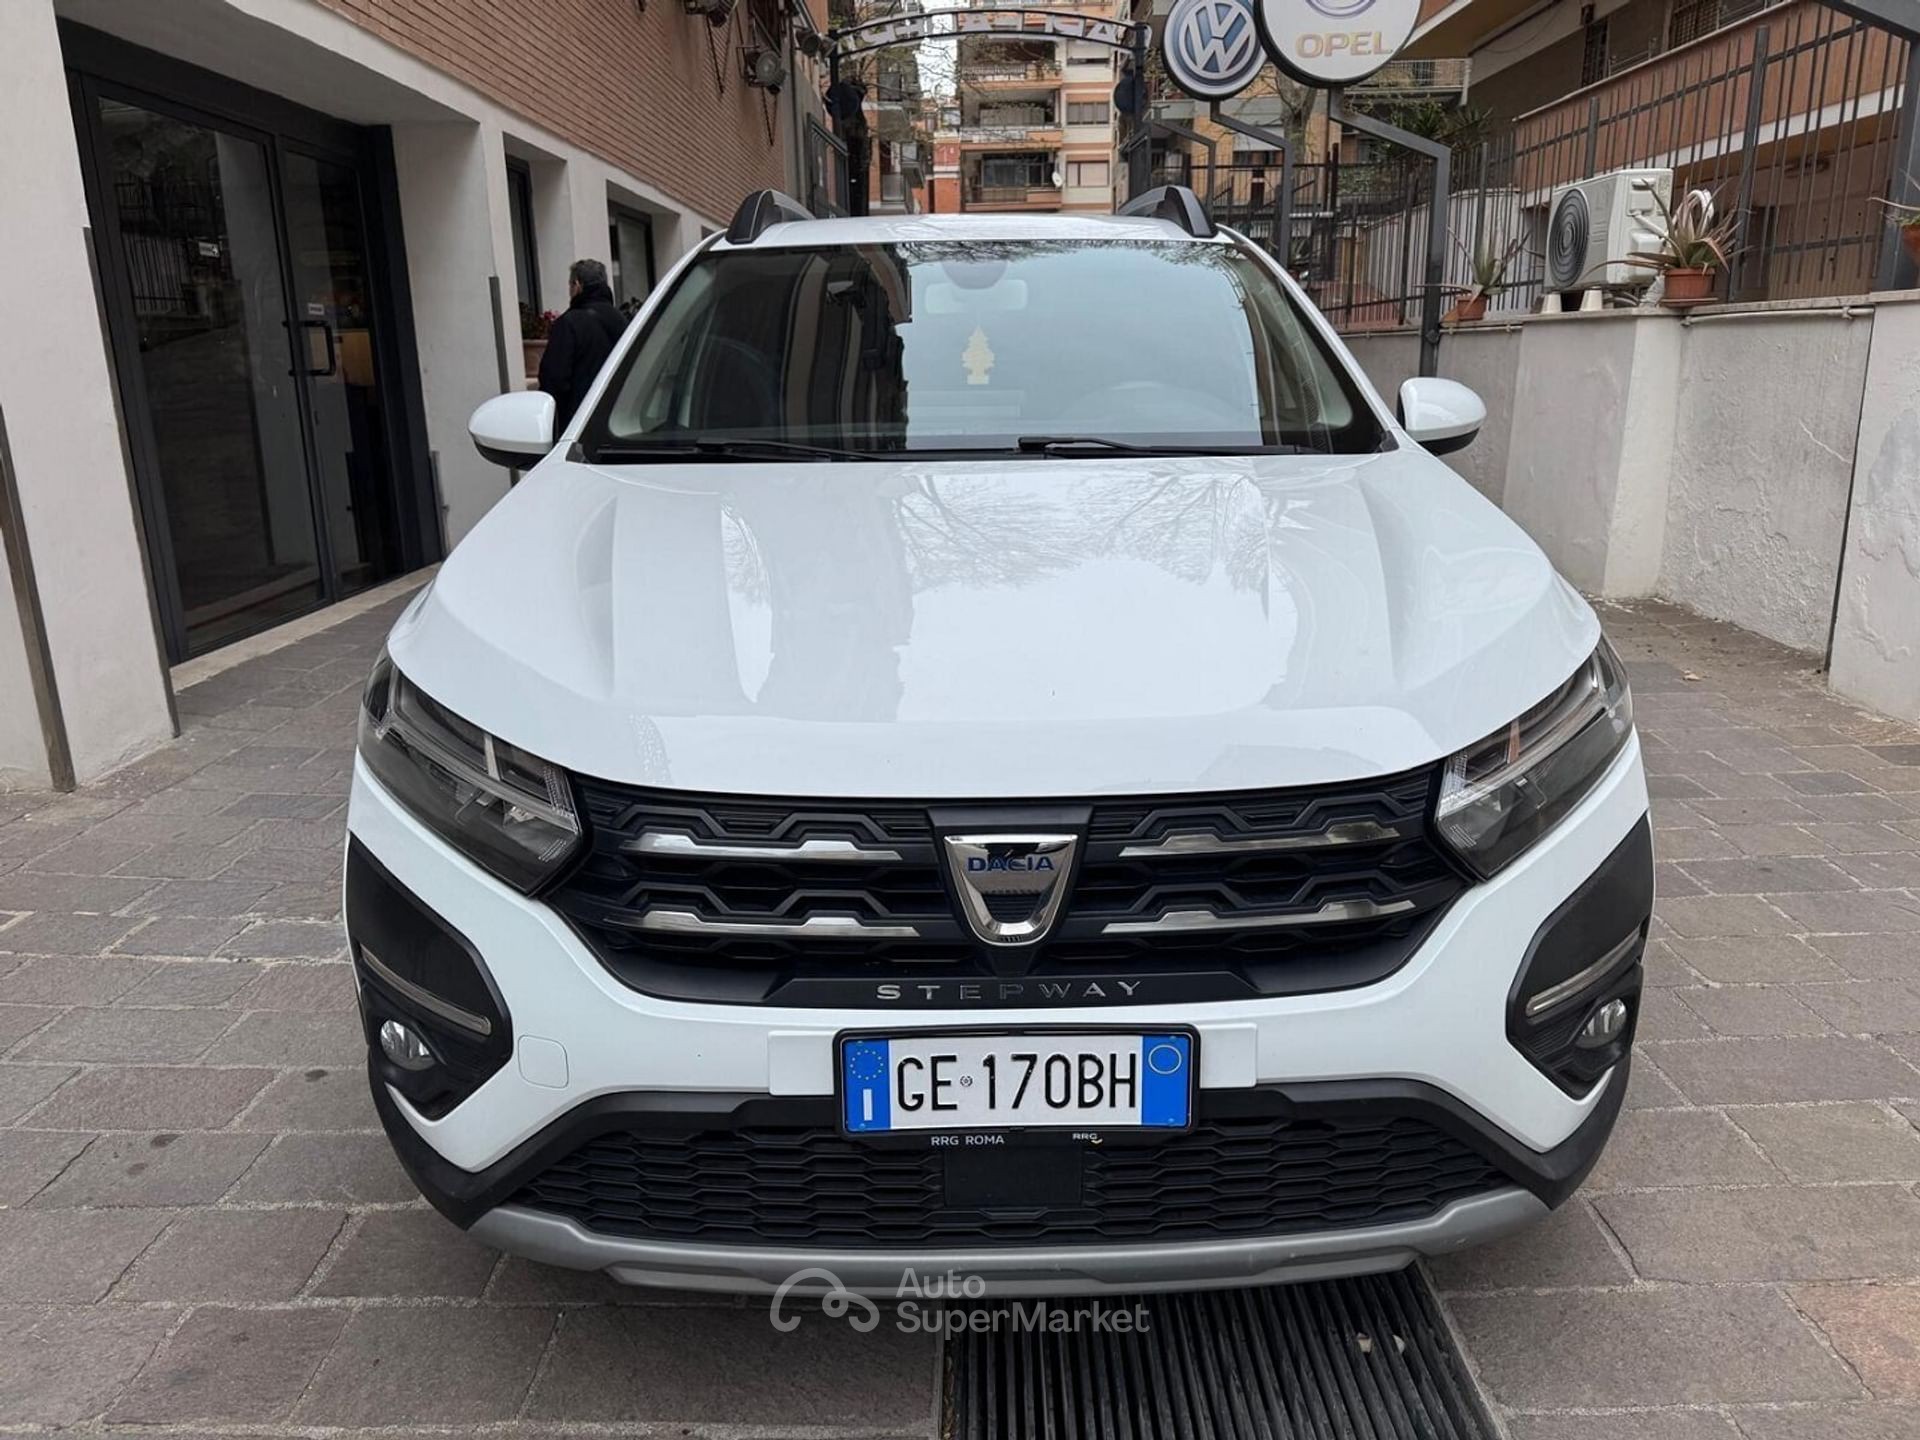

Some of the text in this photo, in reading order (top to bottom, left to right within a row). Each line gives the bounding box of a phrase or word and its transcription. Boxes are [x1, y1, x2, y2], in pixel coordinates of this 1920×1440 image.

[1295, 31, 1392, 58] OPEL
[967, 856, 1054, 872] DACIA
[876, 981, 1140, 1000] STEPWAY
[897, 1053, 1137, 1111] GE 170BH
[931, 1134, 1005, 1146] RRG ROMA
[1072, 1133, 1098, 1141] RRG
